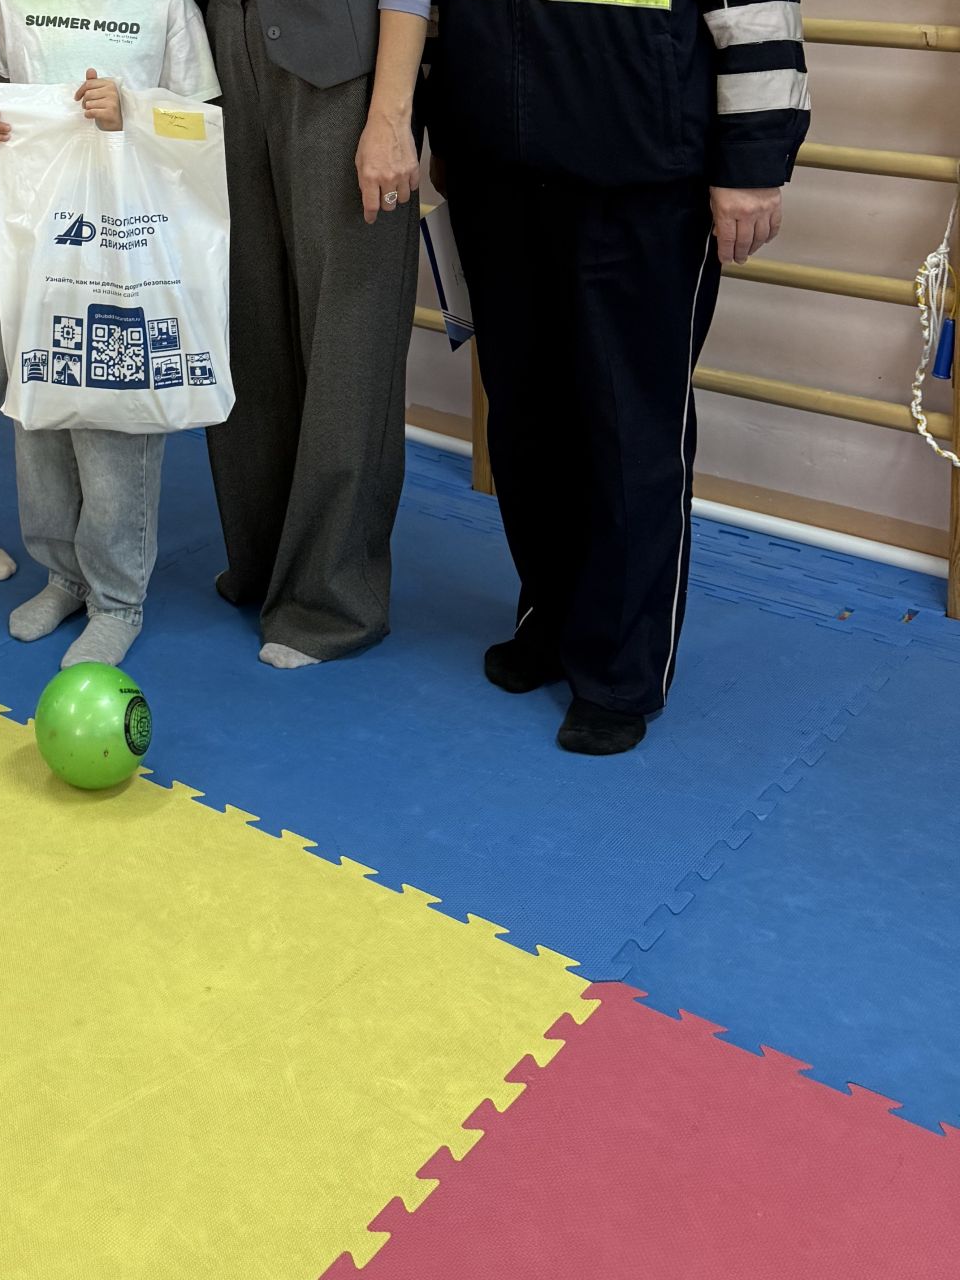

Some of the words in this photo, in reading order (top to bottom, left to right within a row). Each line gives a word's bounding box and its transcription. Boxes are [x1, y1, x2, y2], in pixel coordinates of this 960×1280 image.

[25, 14, 91, 31] SUMMER
[93, 19, 141, 35] MOOD
[54, 211, 75, 221] ГБУ
[100, 238, 148, 251] ДВИЖЕНИЯ
